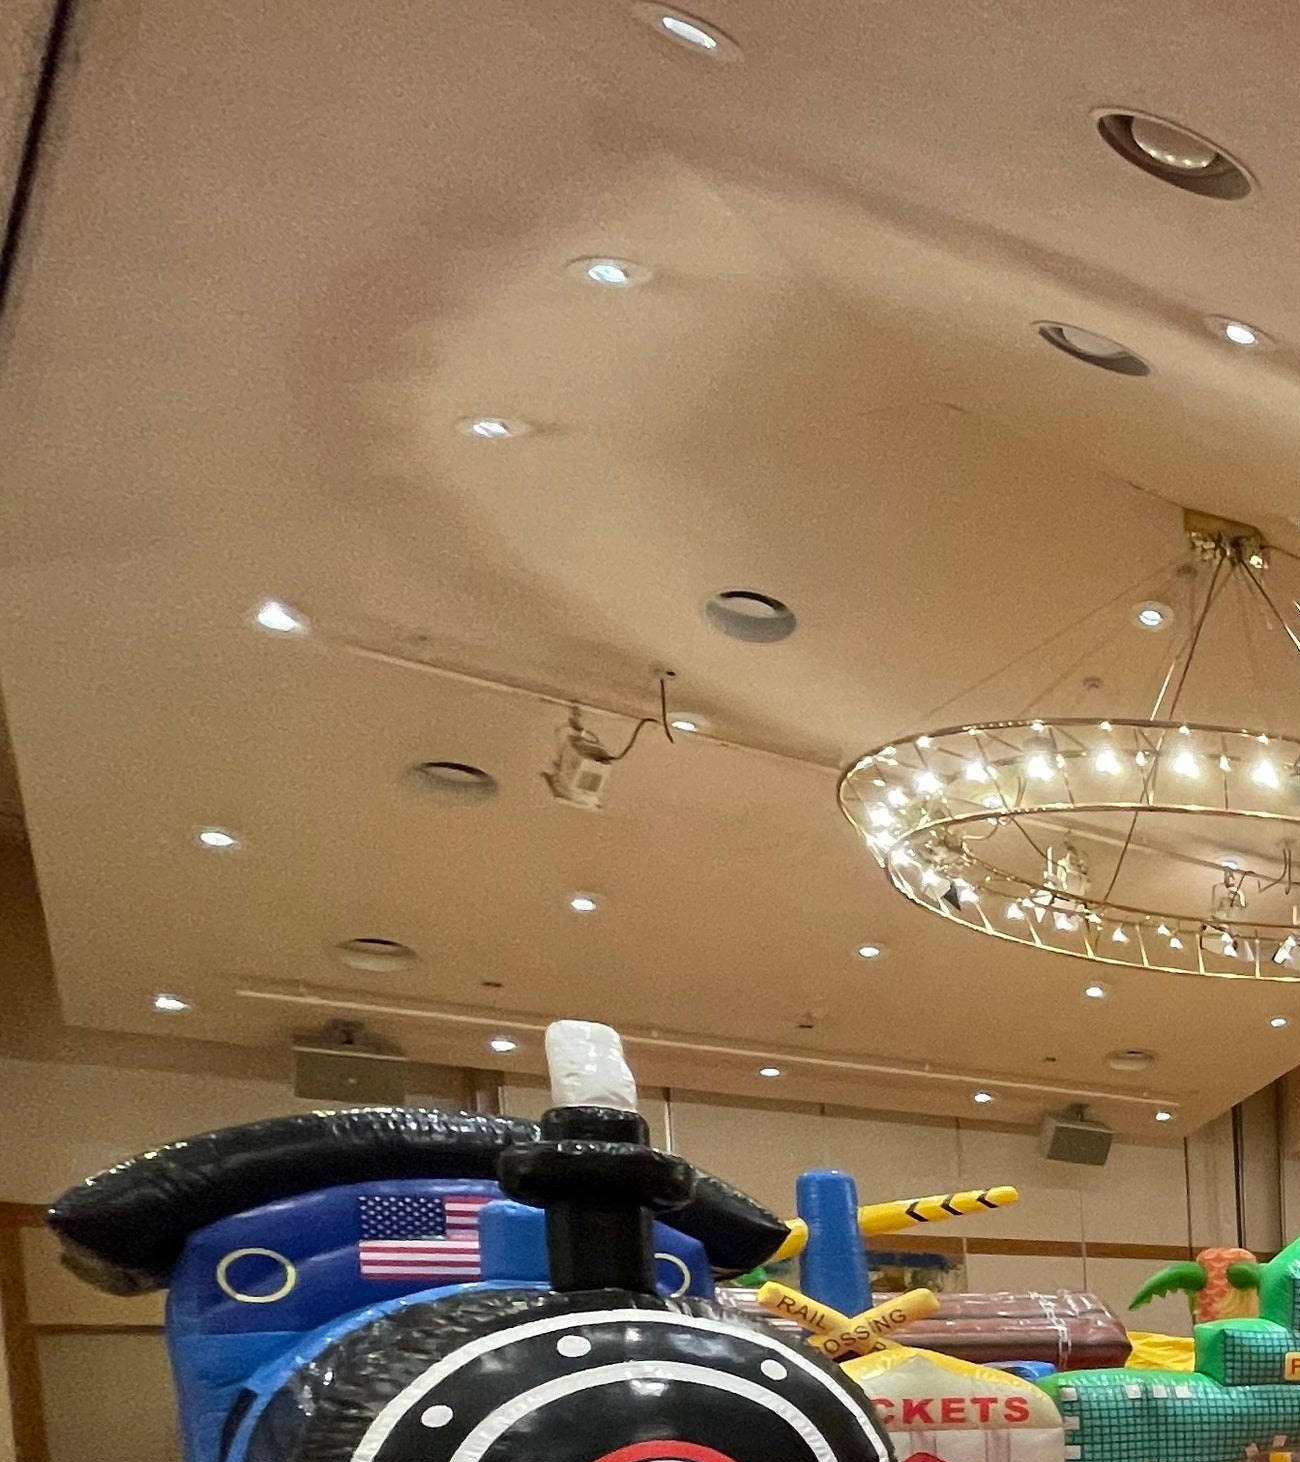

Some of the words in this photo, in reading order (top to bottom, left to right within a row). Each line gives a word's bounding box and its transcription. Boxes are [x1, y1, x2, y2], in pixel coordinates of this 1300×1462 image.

[775, 1294, 828, 1330] RAIL
[822, 1308, 907, 1356] OSSING
[871, 1396, 1030, 1425] CKETS
